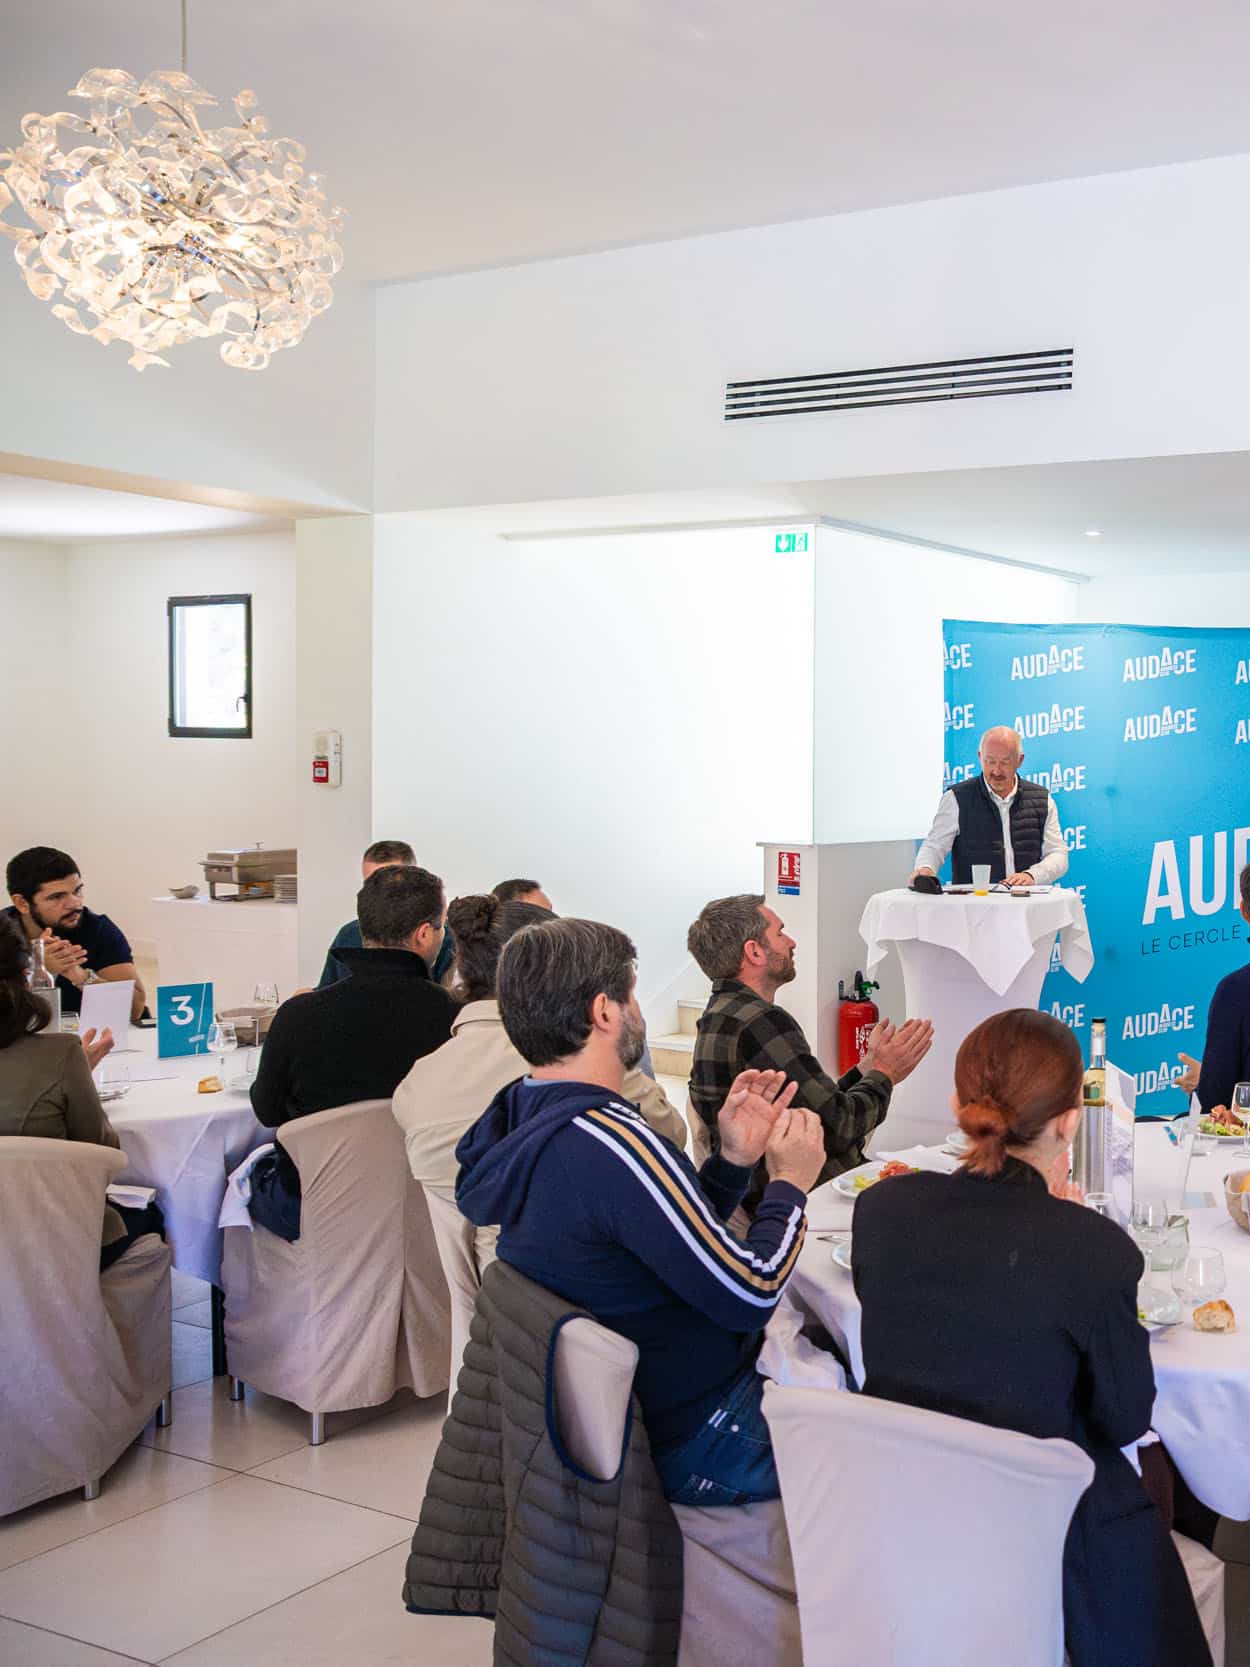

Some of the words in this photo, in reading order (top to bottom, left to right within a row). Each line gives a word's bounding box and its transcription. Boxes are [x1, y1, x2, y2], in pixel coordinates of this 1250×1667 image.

[1010, 645, 1086, 681] AUDACE
[1122, 646, 1198, 683] AUDACE
[1014, 703, 1087, 740] AUDACE
[1122, 704, 1198, 743] AUDACE
[1141, 937, 1161, 956] LE
[1168, 924, 1241, 951] CERCLE
[170, 995, 195, 1025] 3
[1121, 1002, 1196, 1041] AUDACE
